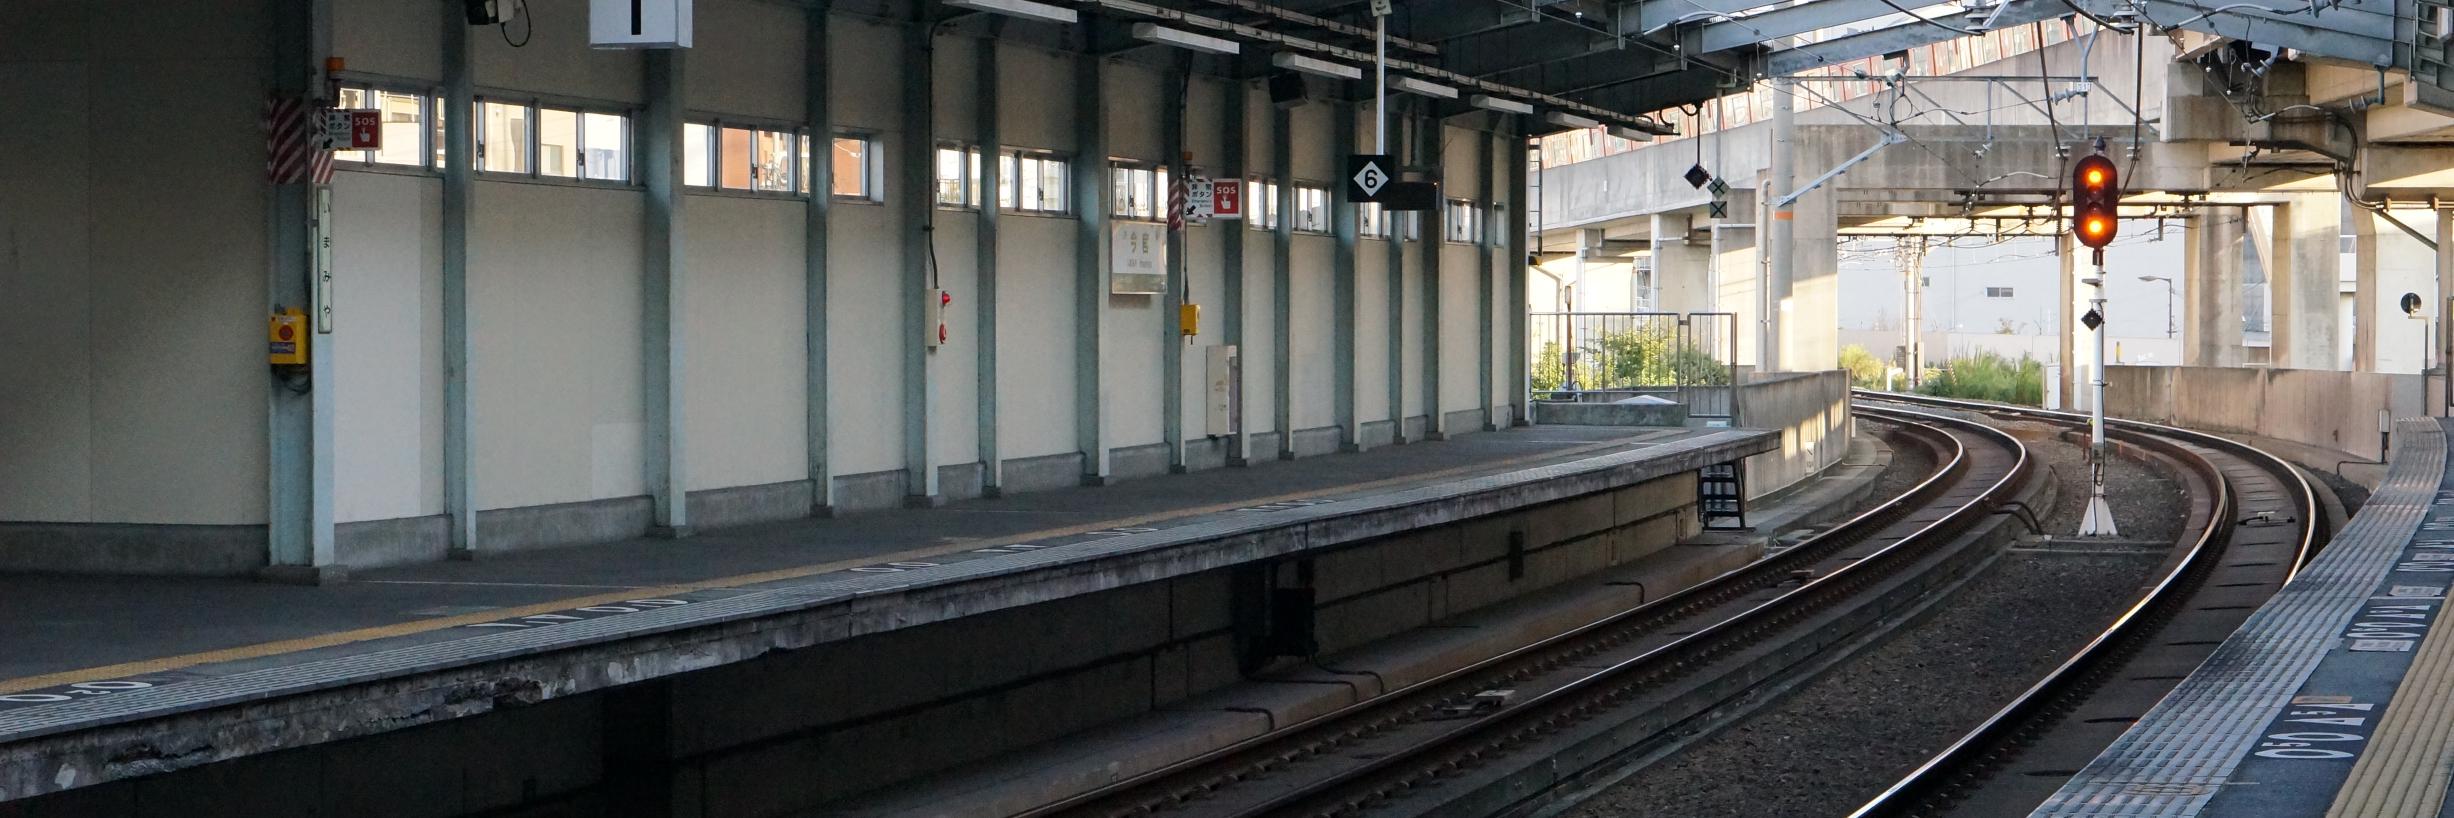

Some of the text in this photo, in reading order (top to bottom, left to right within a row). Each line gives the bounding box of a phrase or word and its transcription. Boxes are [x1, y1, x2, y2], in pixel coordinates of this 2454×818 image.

[355, 117, 376, 126] SOS
[1365, 169, 1377, 188] 6
[1216, 186, 1236, 194] SOS
